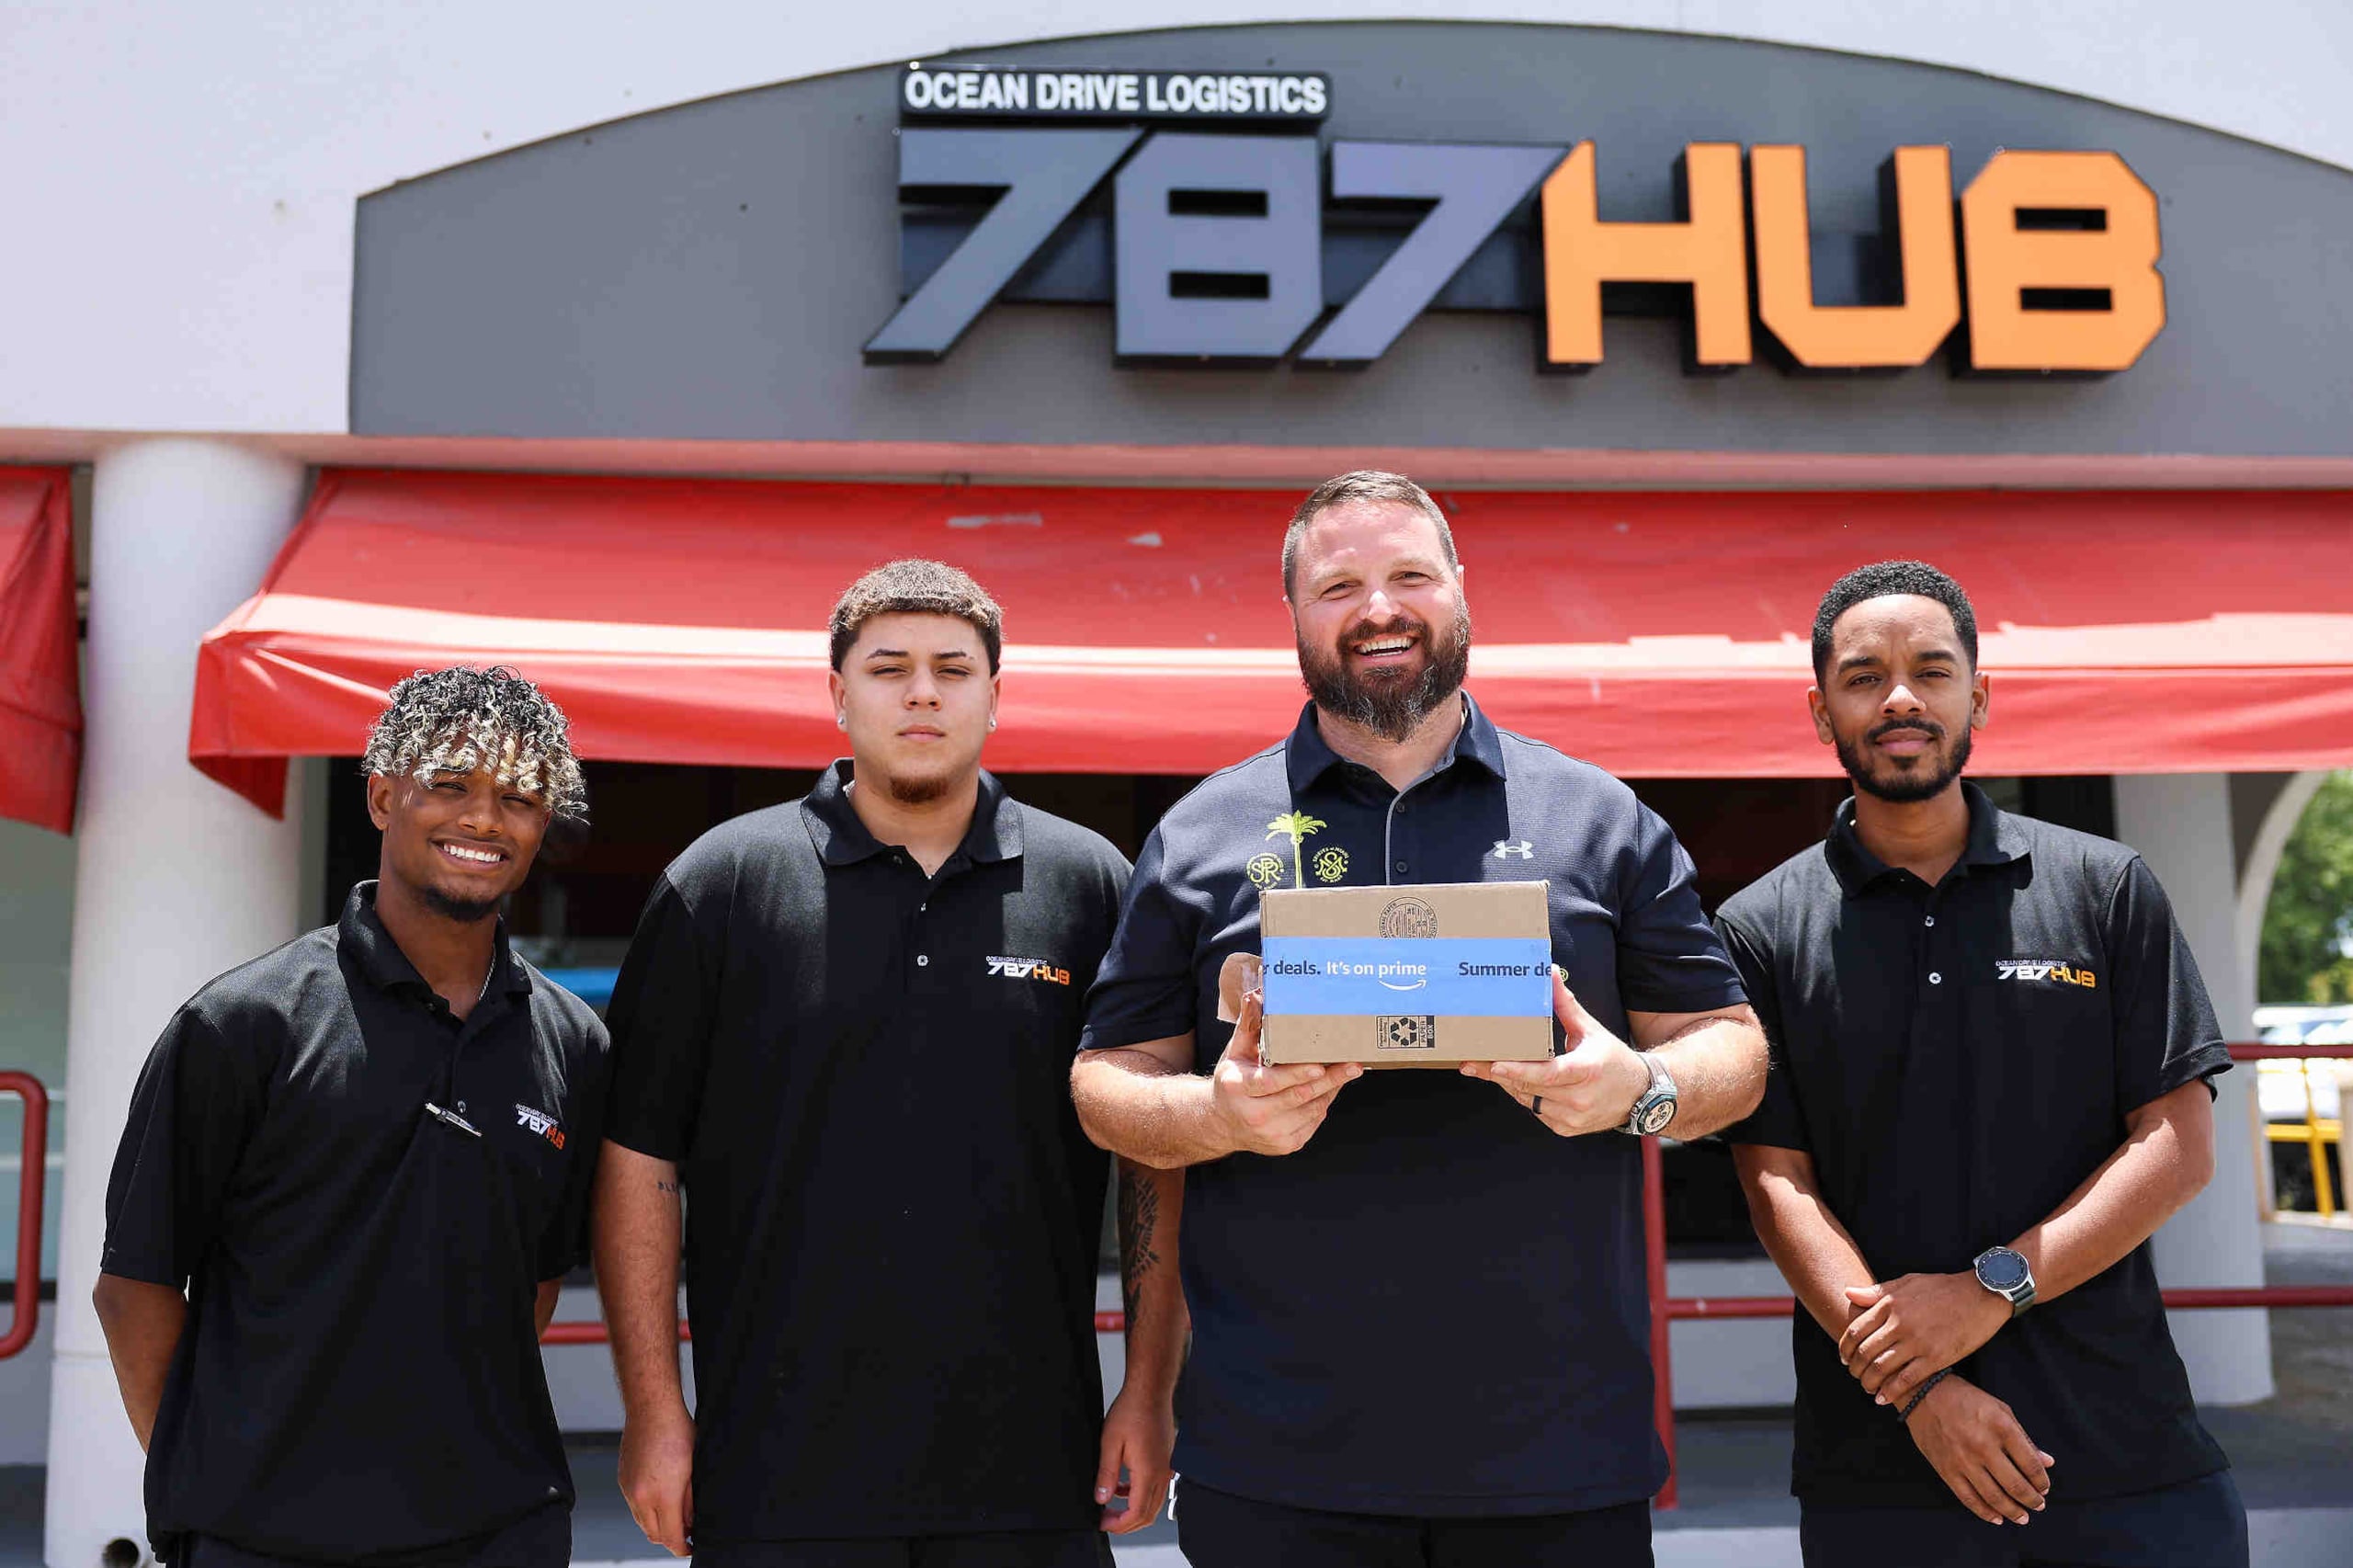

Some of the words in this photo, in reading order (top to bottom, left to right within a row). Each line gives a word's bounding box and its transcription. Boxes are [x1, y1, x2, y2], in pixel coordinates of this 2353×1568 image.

[905, 72, 1029, 110] OCEAN
[1035, 73, 1141, 111] DRIVE
[1146, 74, 1327, 114] LOGISTICS
[1273, 960, 1321, 975] deals.
[1354, 965, 1374, 976] on
[1379, 960, 1427, 978] prime
[1459, 961, 1530, 977] Summer
